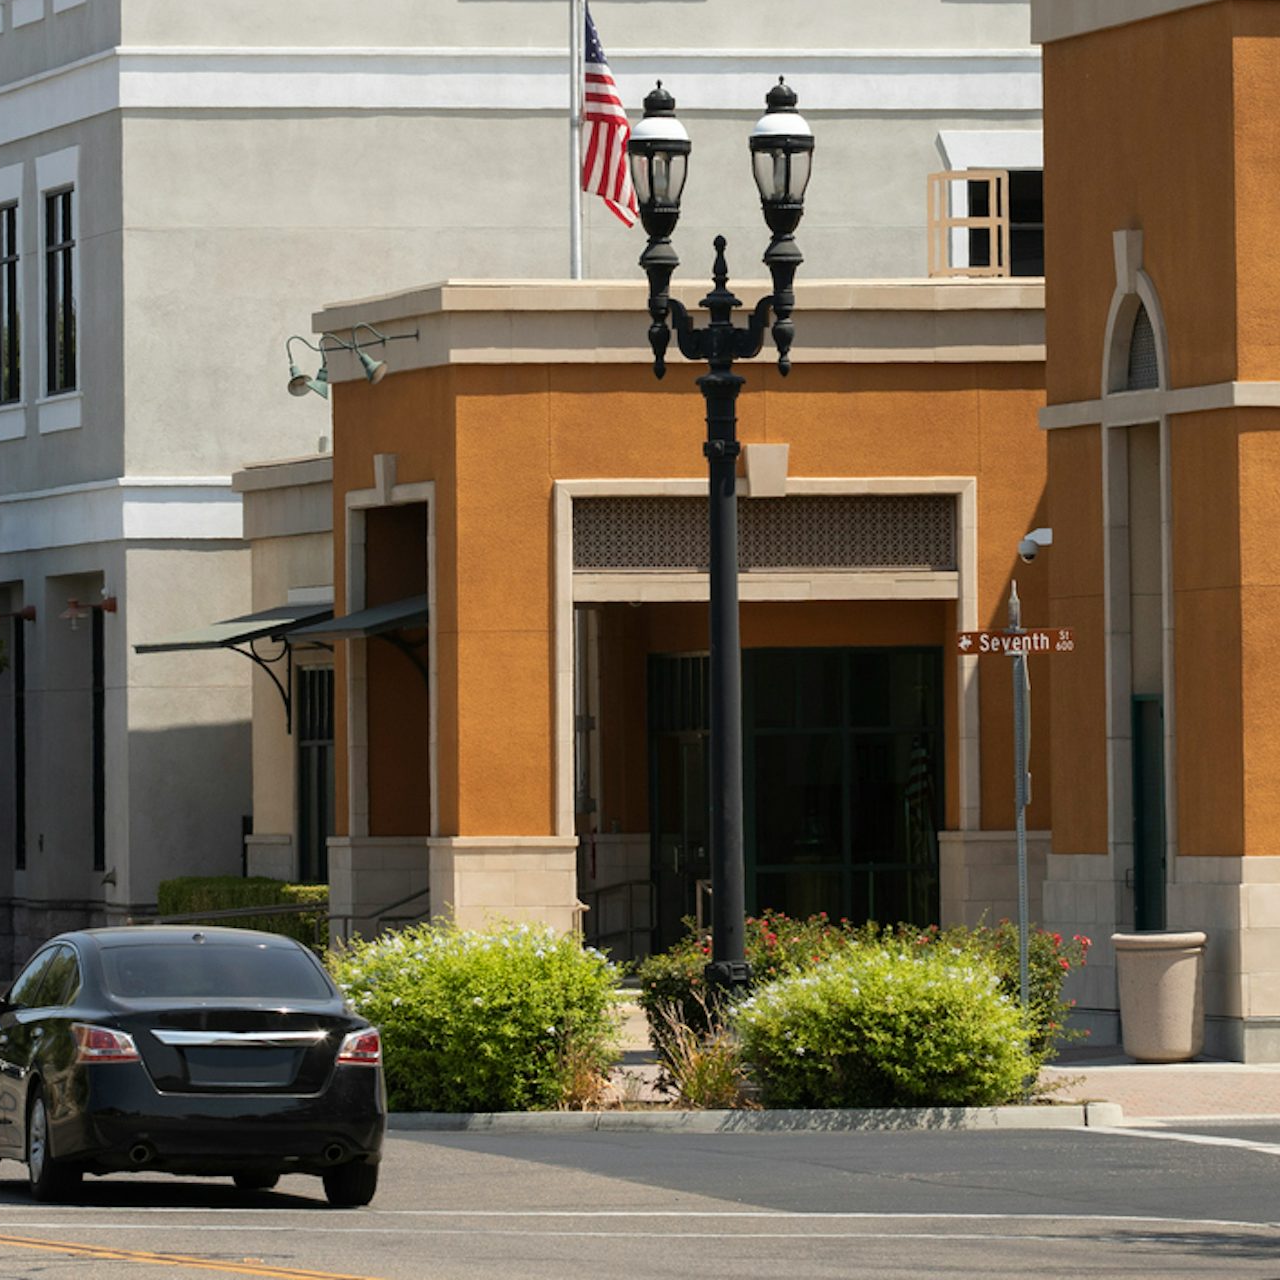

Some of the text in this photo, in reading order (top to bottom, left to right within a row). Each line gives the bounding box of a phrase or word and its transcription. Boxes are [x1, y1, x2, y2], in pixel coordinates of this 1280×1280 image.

[980, 630, 1070, 652] Seventh St
[1055, 640, 1074, 651] 600
